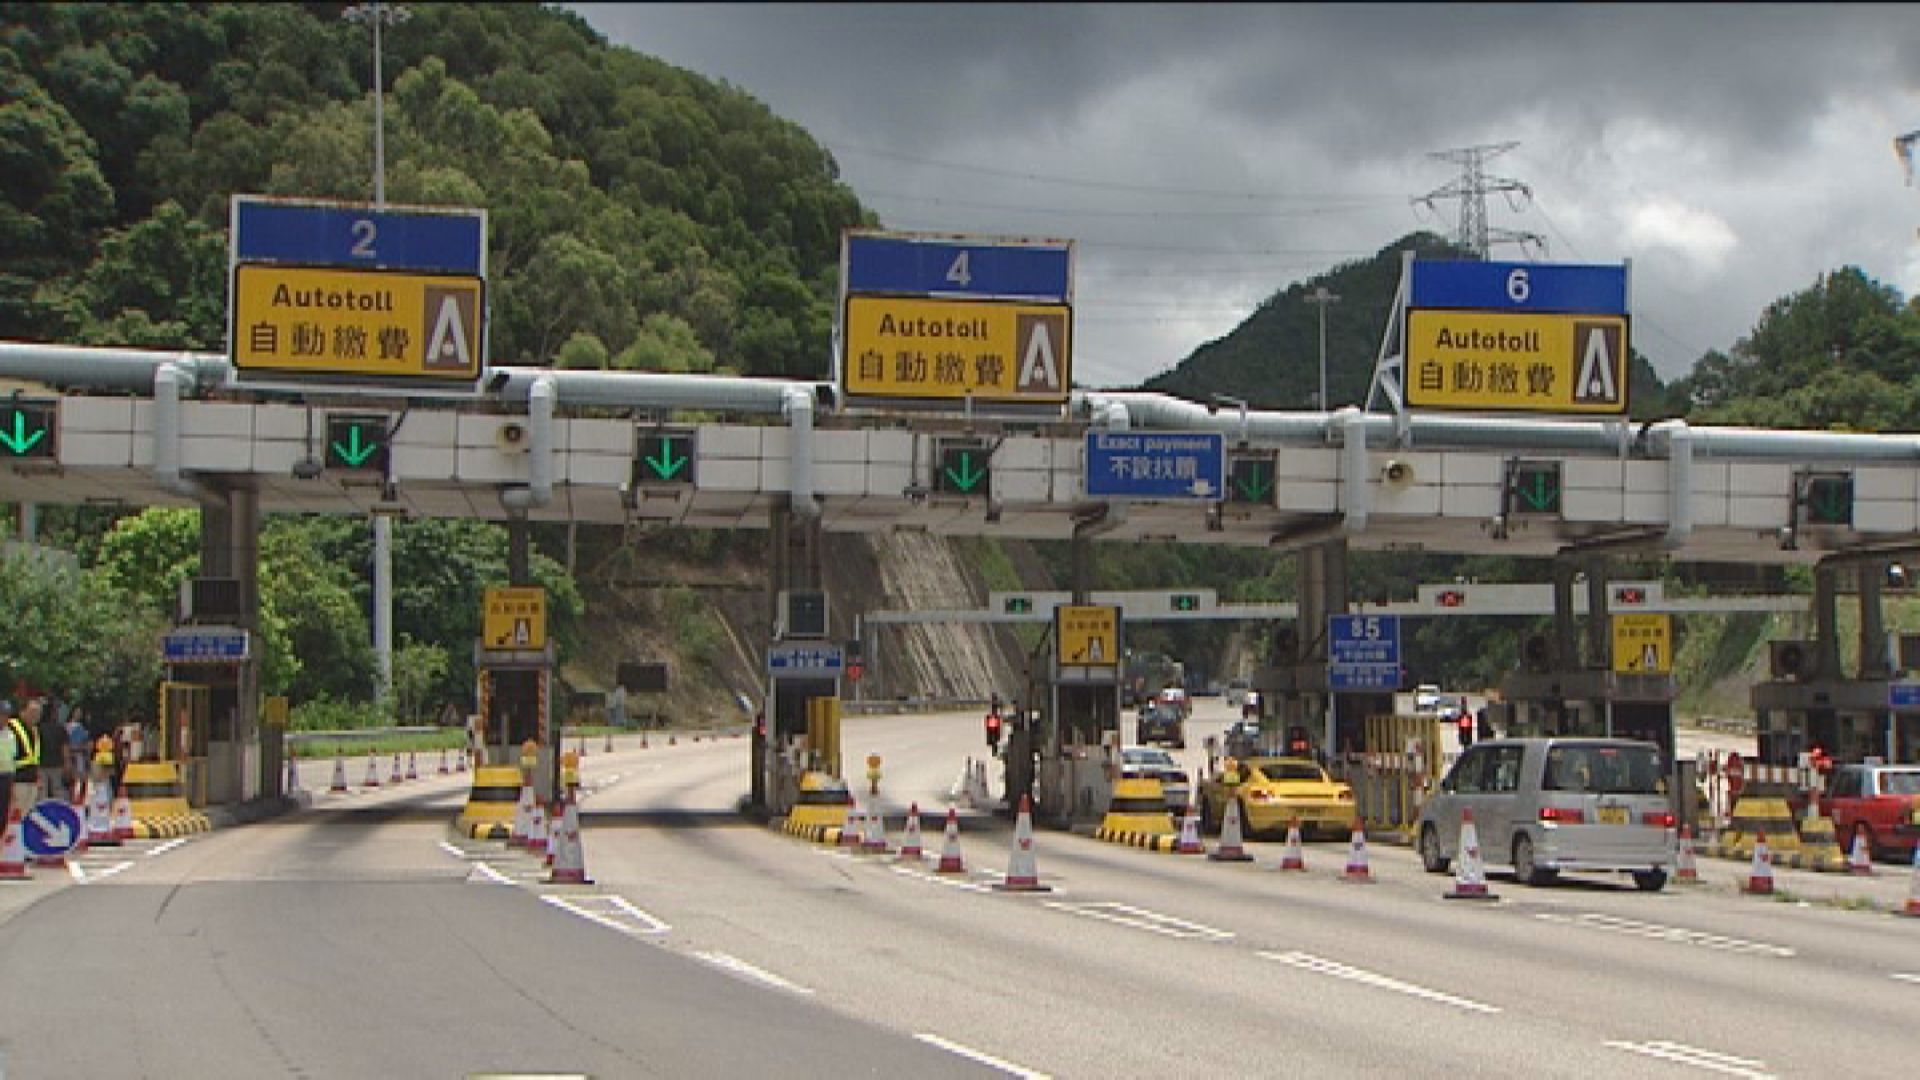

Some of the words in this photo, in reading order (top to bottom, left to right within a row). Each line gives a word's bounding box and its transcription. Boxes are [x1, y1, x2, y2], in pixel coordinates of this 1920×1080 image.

[350, 220, 377, 257] 2
[946, 250, 971, 286] 4
[1507, 268, 1530, 302] 6
[271, 284, 394, 312] Autotoll
[250, 321, 410, 362] 自動繳費
[879, 313, 988, 340] Autotoll
[1436, 327, 1541, 353] Autotoll
[859, 348, 1004, 386] 自動繳費
[1419, 359, 1556, 397] 自動繳費
[1144, 438, 1212, 453] payment
